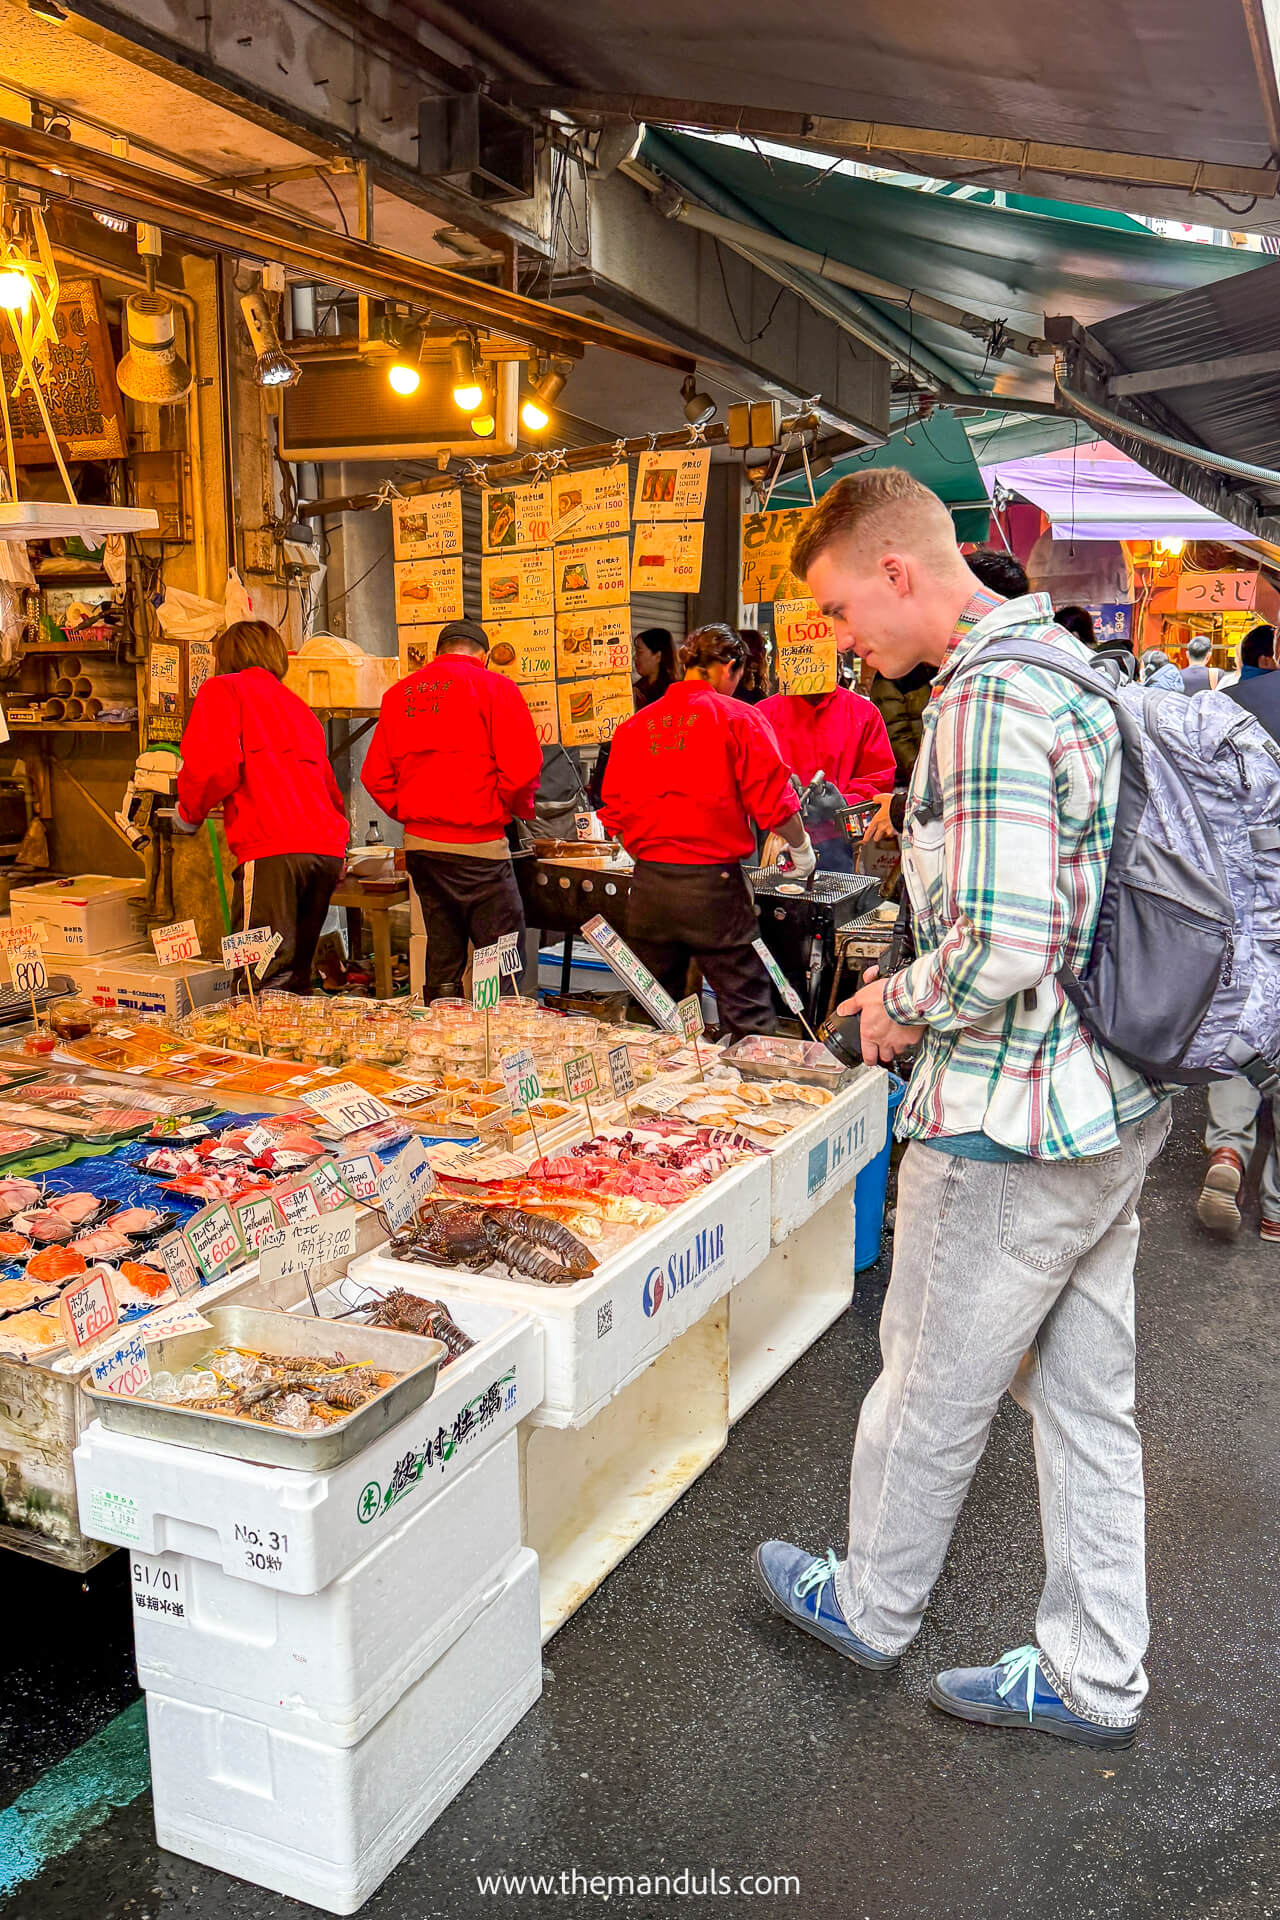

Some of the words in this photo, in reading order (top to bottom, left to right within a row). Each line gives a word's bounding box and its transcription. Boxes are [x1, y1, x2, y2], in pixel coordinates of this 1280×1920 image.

[605, 500, 623, 509] 1500
[598, 580, 625, 591] 400円
[1186, 580, 1251, 603] つきじ
[65, 935, 84, 943] 10/15
[171, 941, 192, 961] 500
[16, 961, 45, 992] 800
[518, 1074, 540, 1104] 500
[268, 1531, 289, 1554] 31
[133, 1563, 180, 1592] 10/15
